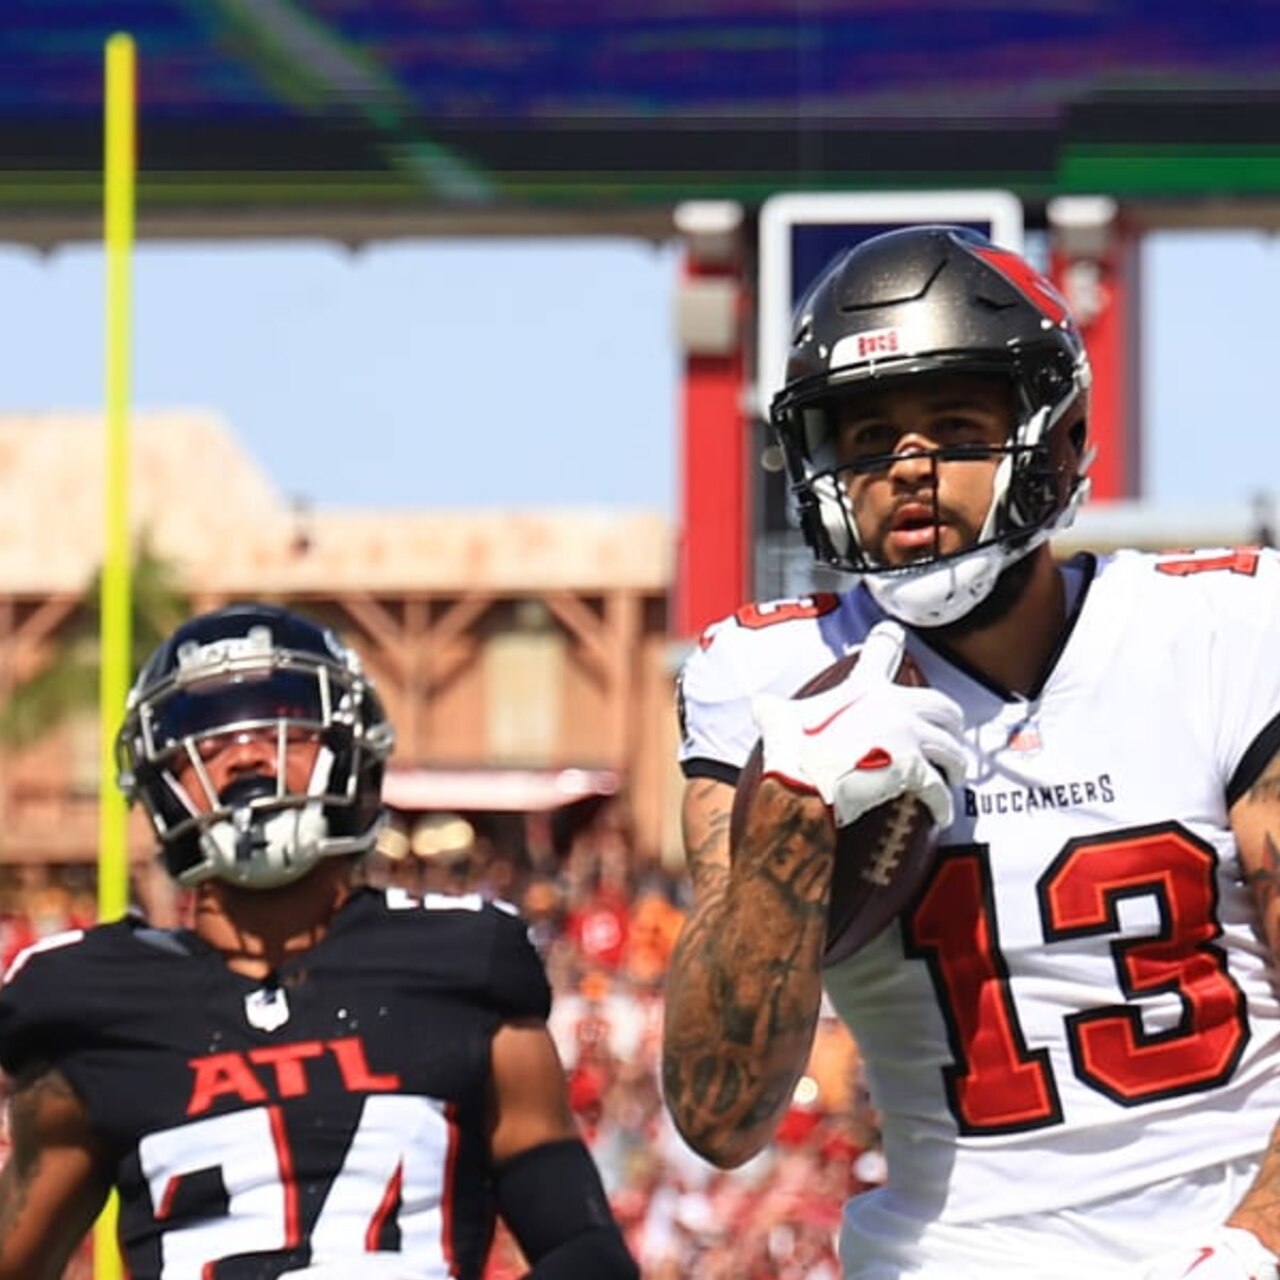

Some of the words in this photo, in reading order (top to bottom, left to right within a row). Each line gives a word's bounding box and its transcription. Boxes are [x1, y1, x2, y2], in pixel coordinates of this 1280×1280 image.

[963, 773, 1115, 818] BUCCANEERS
[903, 820, 1252, 1136] 13
[186, 1036, 401, 1117] ATL
